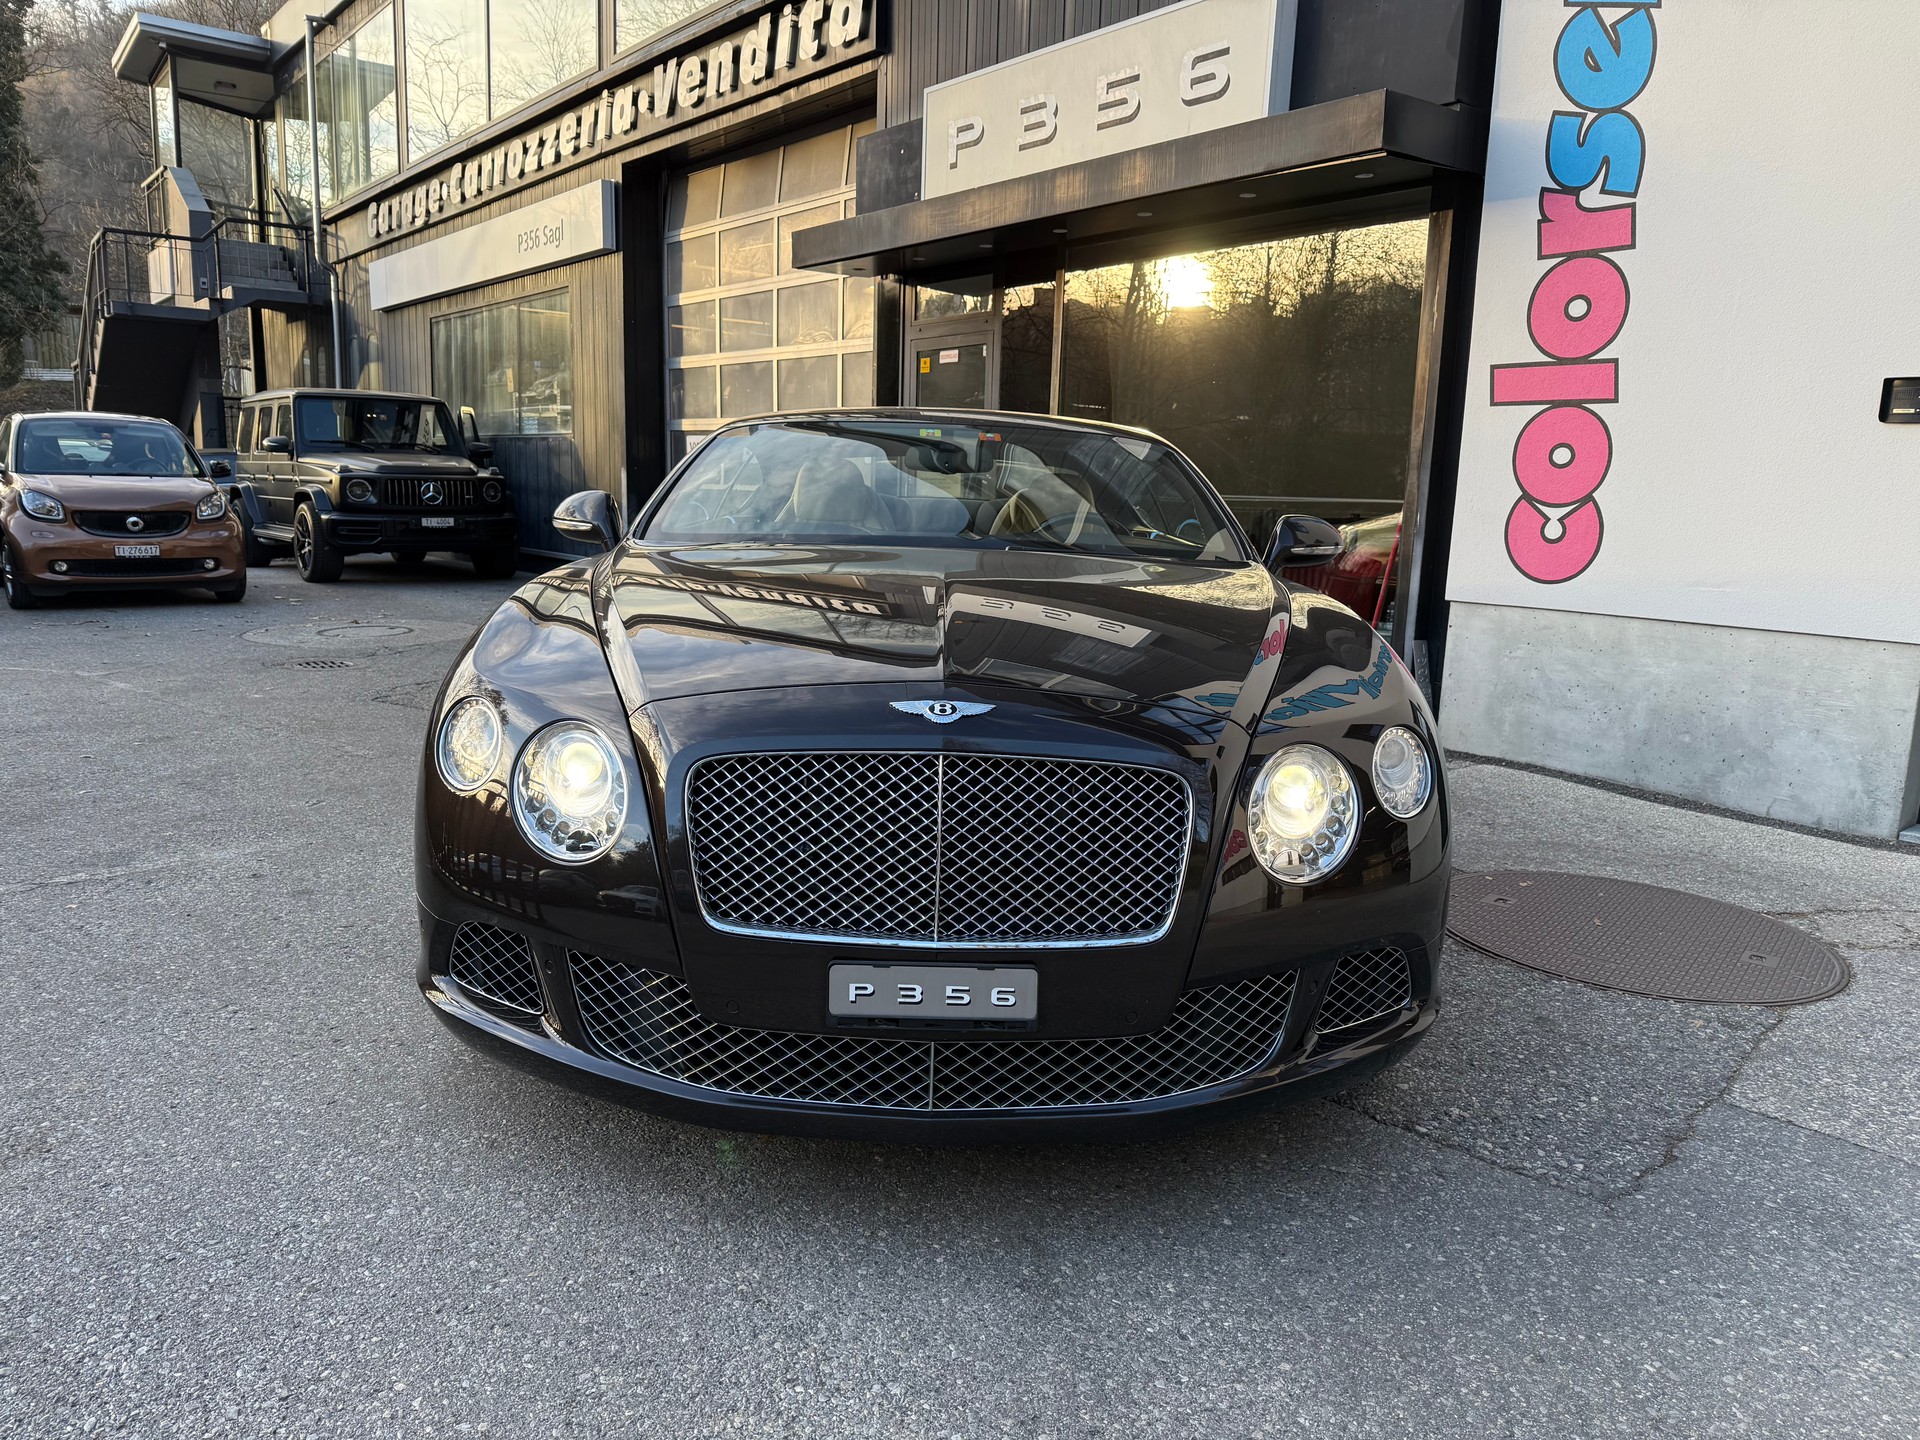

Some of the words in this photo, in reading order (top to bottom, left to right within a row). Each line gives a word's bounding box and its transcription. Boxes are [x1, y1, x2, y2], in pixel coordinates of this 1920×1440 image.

[367, 178, 441, 238] Garage
[654, 0, 863, 118] Vendita
[518, 227, 540, 253] P356
[1490, 0, 1662, 584] colorse
